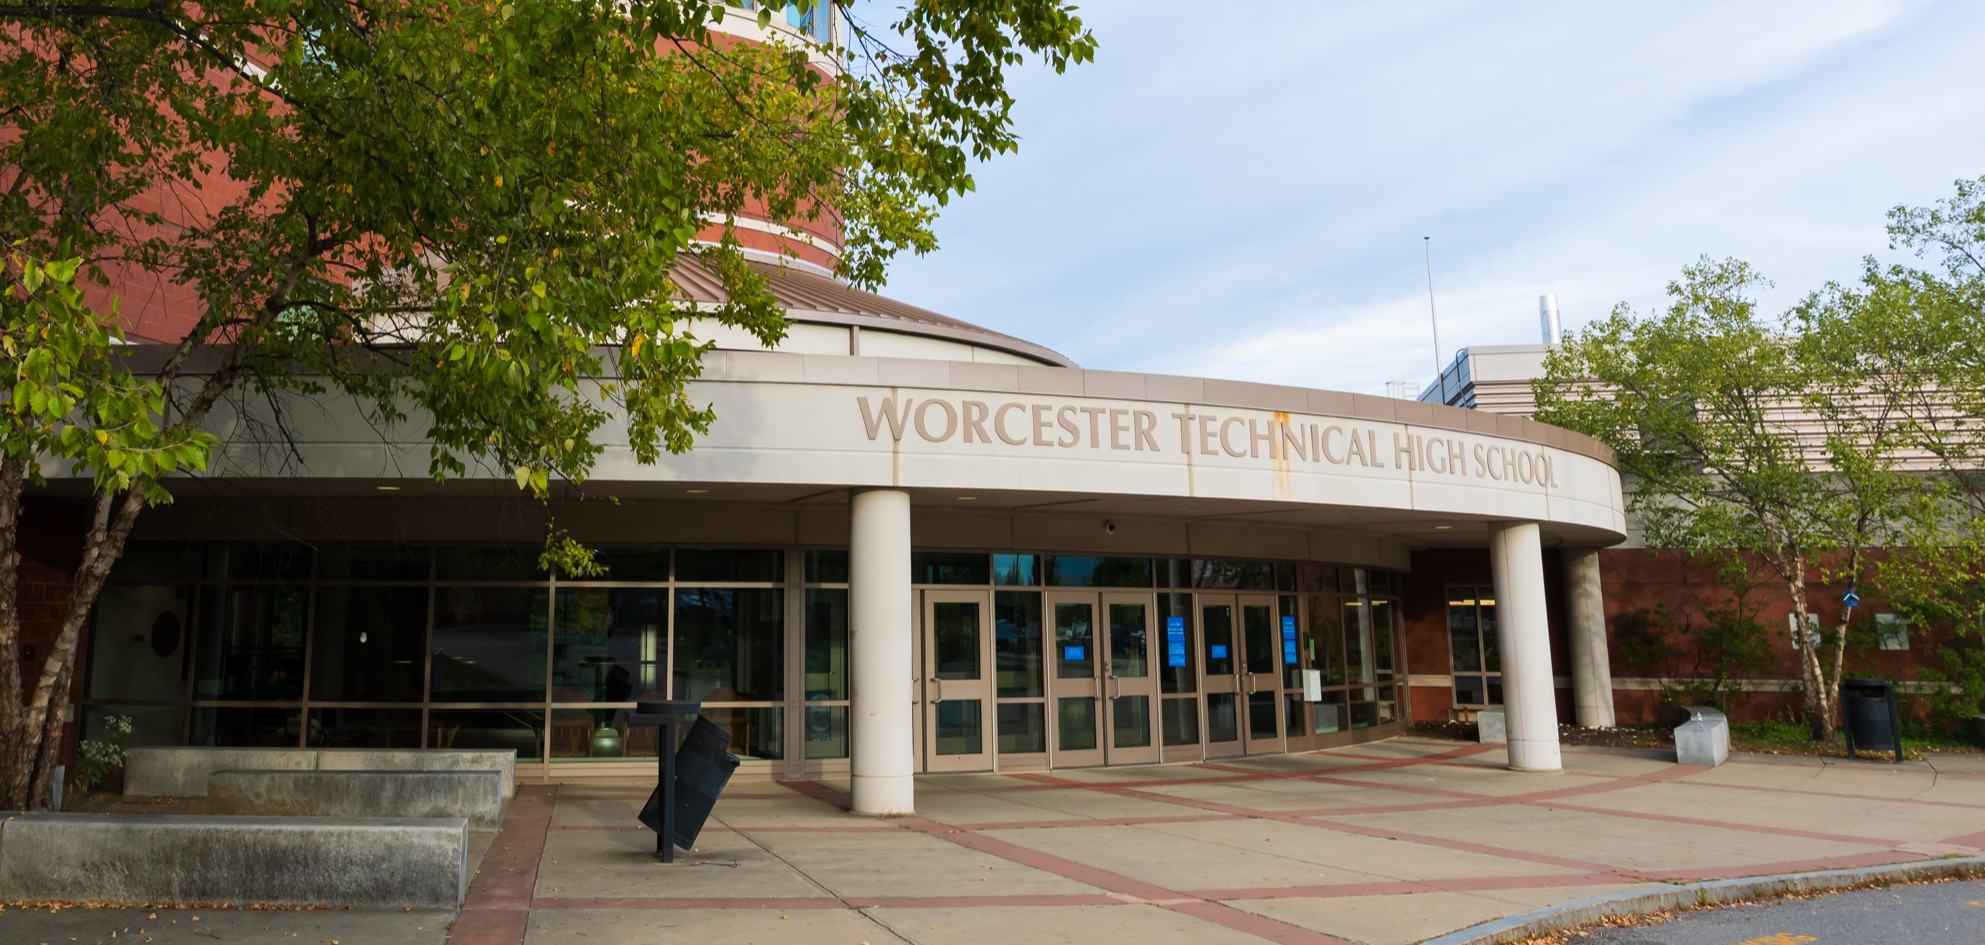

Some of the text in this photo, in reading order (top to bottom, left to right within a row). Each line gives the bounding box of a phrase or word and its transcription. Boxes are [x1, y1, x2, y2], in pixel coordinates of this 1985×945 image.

[857, 396, 1558, 488] WORCESTER TECHNICAL HIGH SCHOOL
